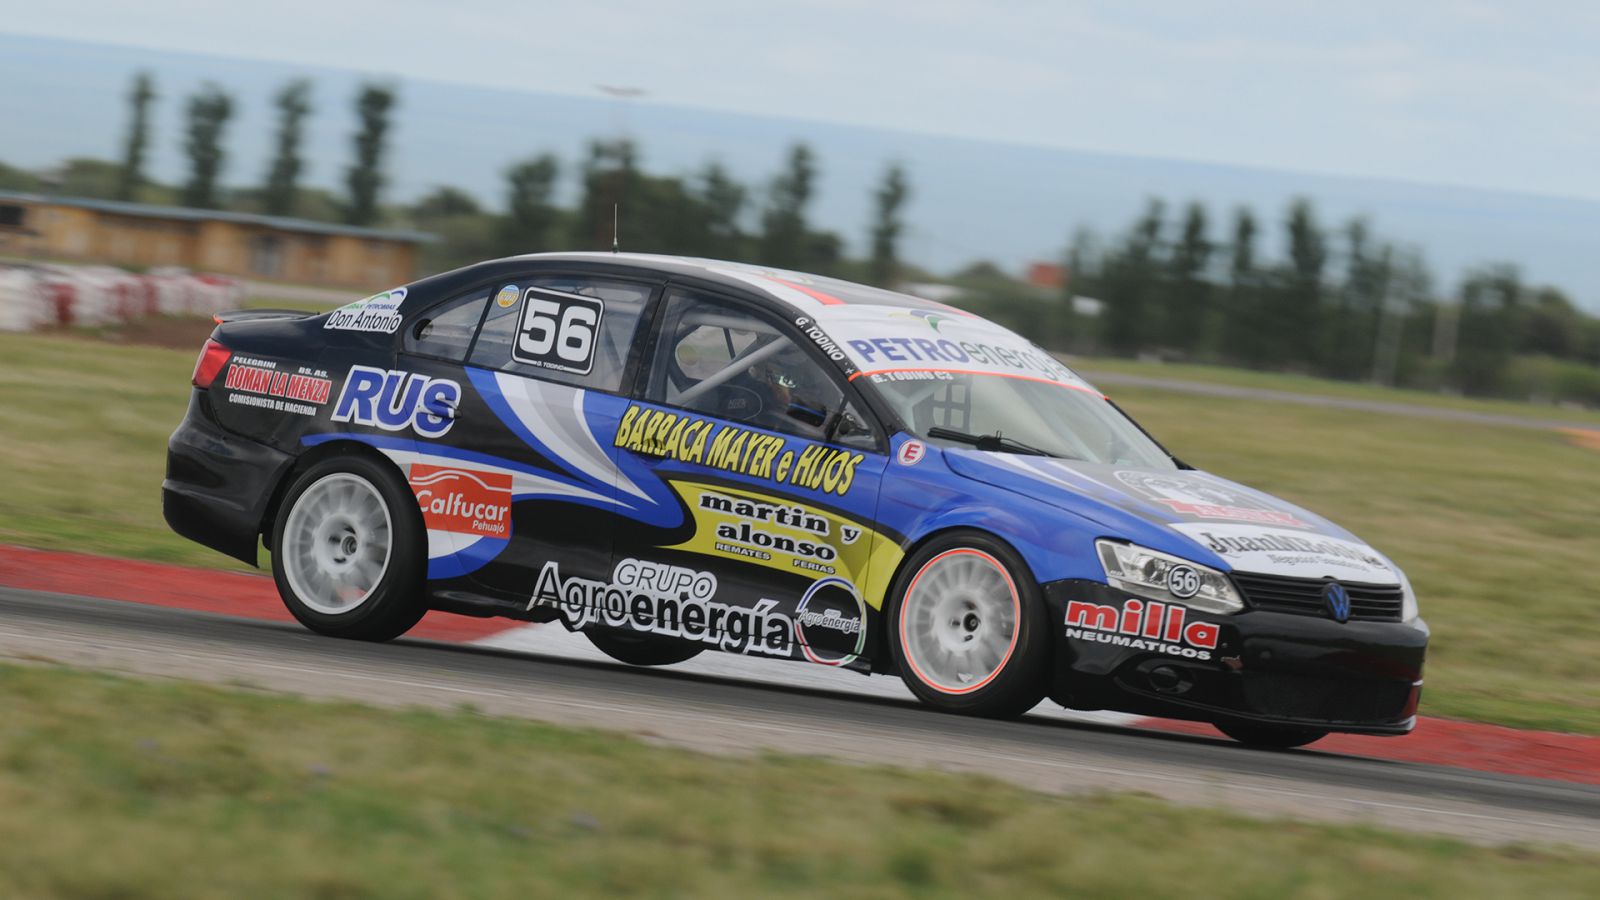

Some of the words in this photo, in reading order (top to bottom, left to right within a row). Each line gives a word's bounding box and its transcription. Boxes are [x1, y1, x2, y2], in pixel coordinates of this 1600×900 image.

[326, 310, 354, 328] Don
[351, 310, 400, 331] Antonio
[519, 298, 597, 362] 56
[795, 316, 809, 328] G.
[805, 326, 845, 361] TODINO
[233, 356, 277, 369] PELEGRINI
[314, 369, 328, 378] AS.
[224, 363, 273, 394] ROMAN
[269, 371, 289, 397] LA
[285, 374, 332, 405] MENZA
[229, 392, 275, 409] COMISIONISTA
[275, 400, 284, 411] DE
[284, 401, 317, 416] HACIENDA
[331, 364, 461, 438] RUS
[614, 405, 708, 464] BARRACA
[705, 426, 784, 479] MAYER
[775, 450, 794, 482] e
[791, 443, 864, 496] HIJOS
[904, 444, 919, 461] E
[416, 490, 508, 521] Calfucar
[699, 493, 828, 534] martin
[842, 524, 861, 542] y
[472, 520, 505, 534] Pehuajó
[716, 523, 836, 562] alonso
[716, 542, 772, 561] REMATES
[793, 558, 836, 574] FERIAS
[613, 558, 717, 601] GRUPO
[1172, 570, 1197, 592] 56
[525, 560, 796, 657] Agroenergía
[799, 607, 861, 634] Agroenergía
[1064, 599, 1221, 650] milla
[1065, 627, 1212, 660] NEUMATICOS
